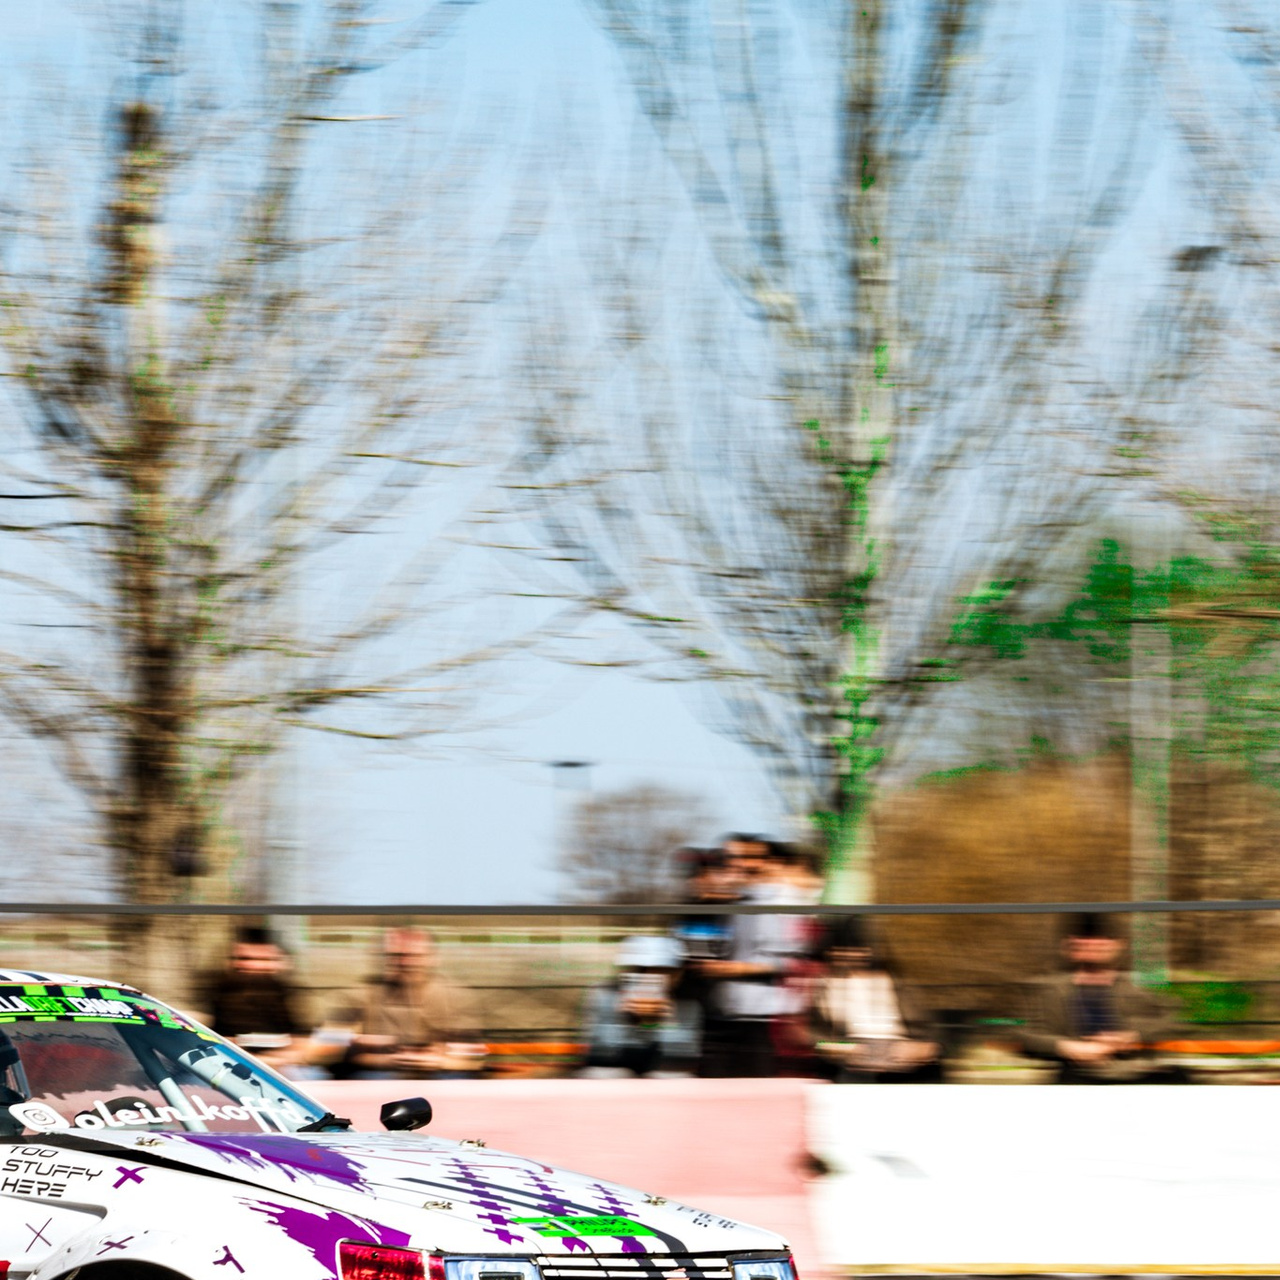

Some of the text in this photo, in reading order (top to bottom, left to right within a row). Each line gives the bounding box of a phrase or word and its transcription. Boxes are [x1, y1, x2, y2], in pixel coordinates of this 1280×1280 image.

[9, 1145, 59, 1158] TOO
[2, 1159, 103, 1181] STUFFY
[1, 1177, 67, 1197] HERE
